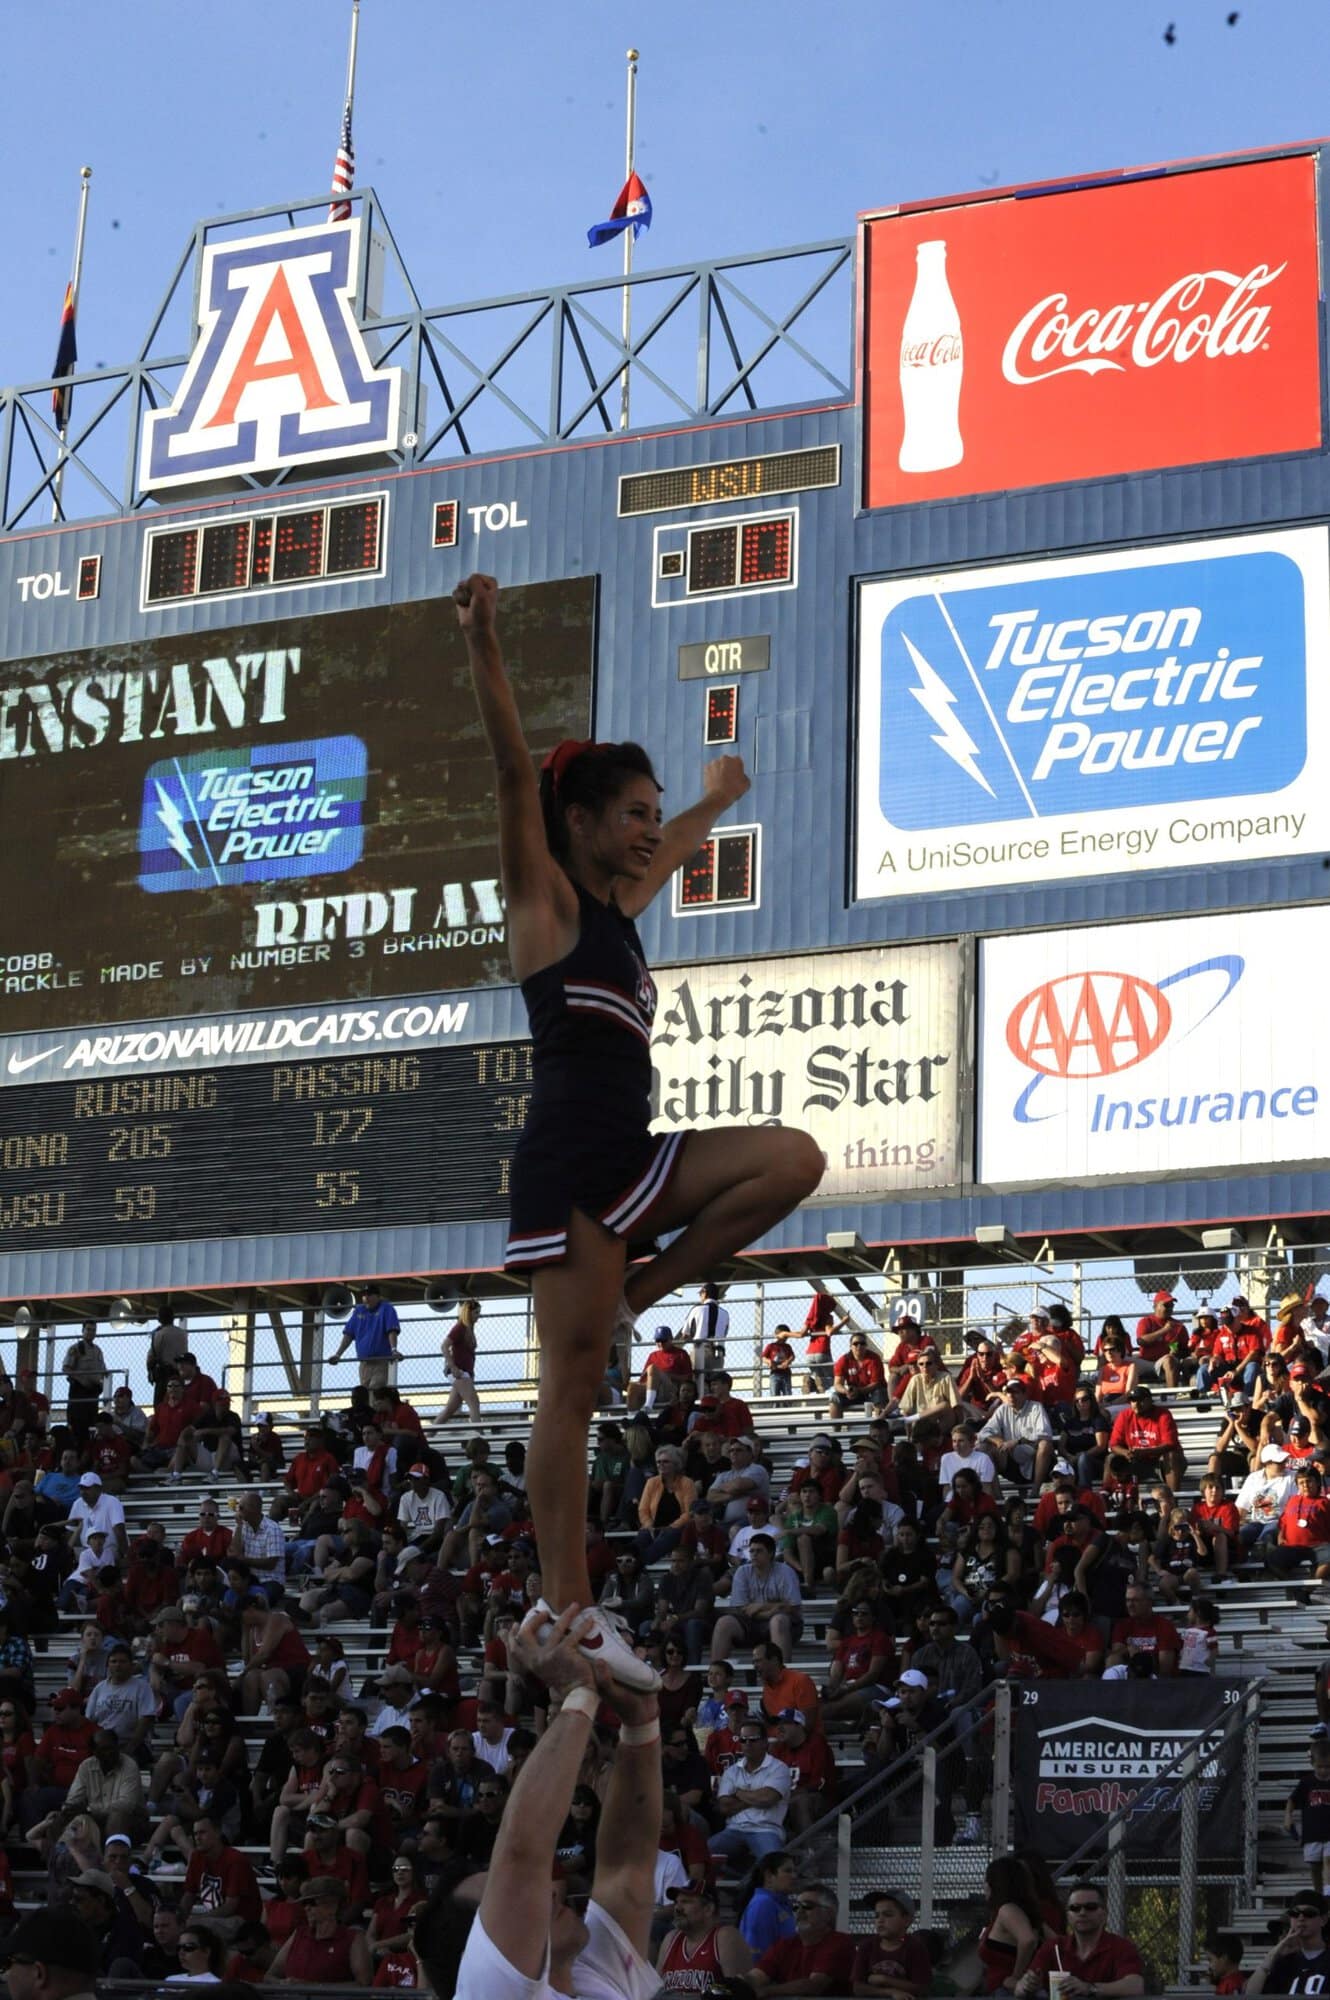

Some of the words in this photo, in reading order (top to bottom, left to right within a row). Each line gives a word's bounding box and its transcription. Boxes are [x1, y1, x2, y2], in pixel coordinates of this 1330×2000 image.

[1001, 261, 1288, 385] Coca-Cola
[139, 217, 402, 492] A
[691, 461, 763, 502] WSU
[466, 501, 528, 534] TOL
[17, 571, 71, 602] TOL
[705, 642, 742, 673] QTR
[984, 606, 1202, 670] Tucson
[1006, 648, 1264, 724] Electric
[1031, 716, 1263, 781] Power
[197, 766, 314, 802] Tucson
[207, 789, 344, 832] Electric
[219, 827, 342, 864] Power
[877, 850, 897, 875] A
[907, 838, 1050, 872] UniSource
[1060, 826, 1159, 855] Energy
[1168, 813, 1307, 844] Company
[100, 961, 164, 984] MADE
[180, 957, 211, 976] BY
[230, 944, 331, 970] NUMBER
[348, 941, 366, 958] 3
[383, 926, 505, 955] BRANDON
[63, 1002, 469, 1069] ARIZONAWILDCATS.COM
[651, 973, 911, 1047] Arizona
[1020, 971, 1158, 1078] AAA
[74, 1075, 218, 1118] RUSHING
[272, 1056, 421, 1102] PASSING
[803, 1045, 950, 1113] Star
[1090, 1085, 1319, 1133] Insurance
[0, 1132, 69, 1169] ONA
[108, 1124, 173, 1162] 205
[312, 1107, 374, 1146] 177
[843, 1137, 945, 1172] thing.
[114, 1186, 156, 1221] 59
[315, 1170, 360, 1207] 55
[1023, 1691, 1039, 1705] 29
[1223, 1690, 1240, 1704] 30
[1040, 1741, 1142, 1758] AMERICAN
[1150, 1741, 1220, 1758] FAMLY
[1053, 1763, 1187, 1775] INSURANC
